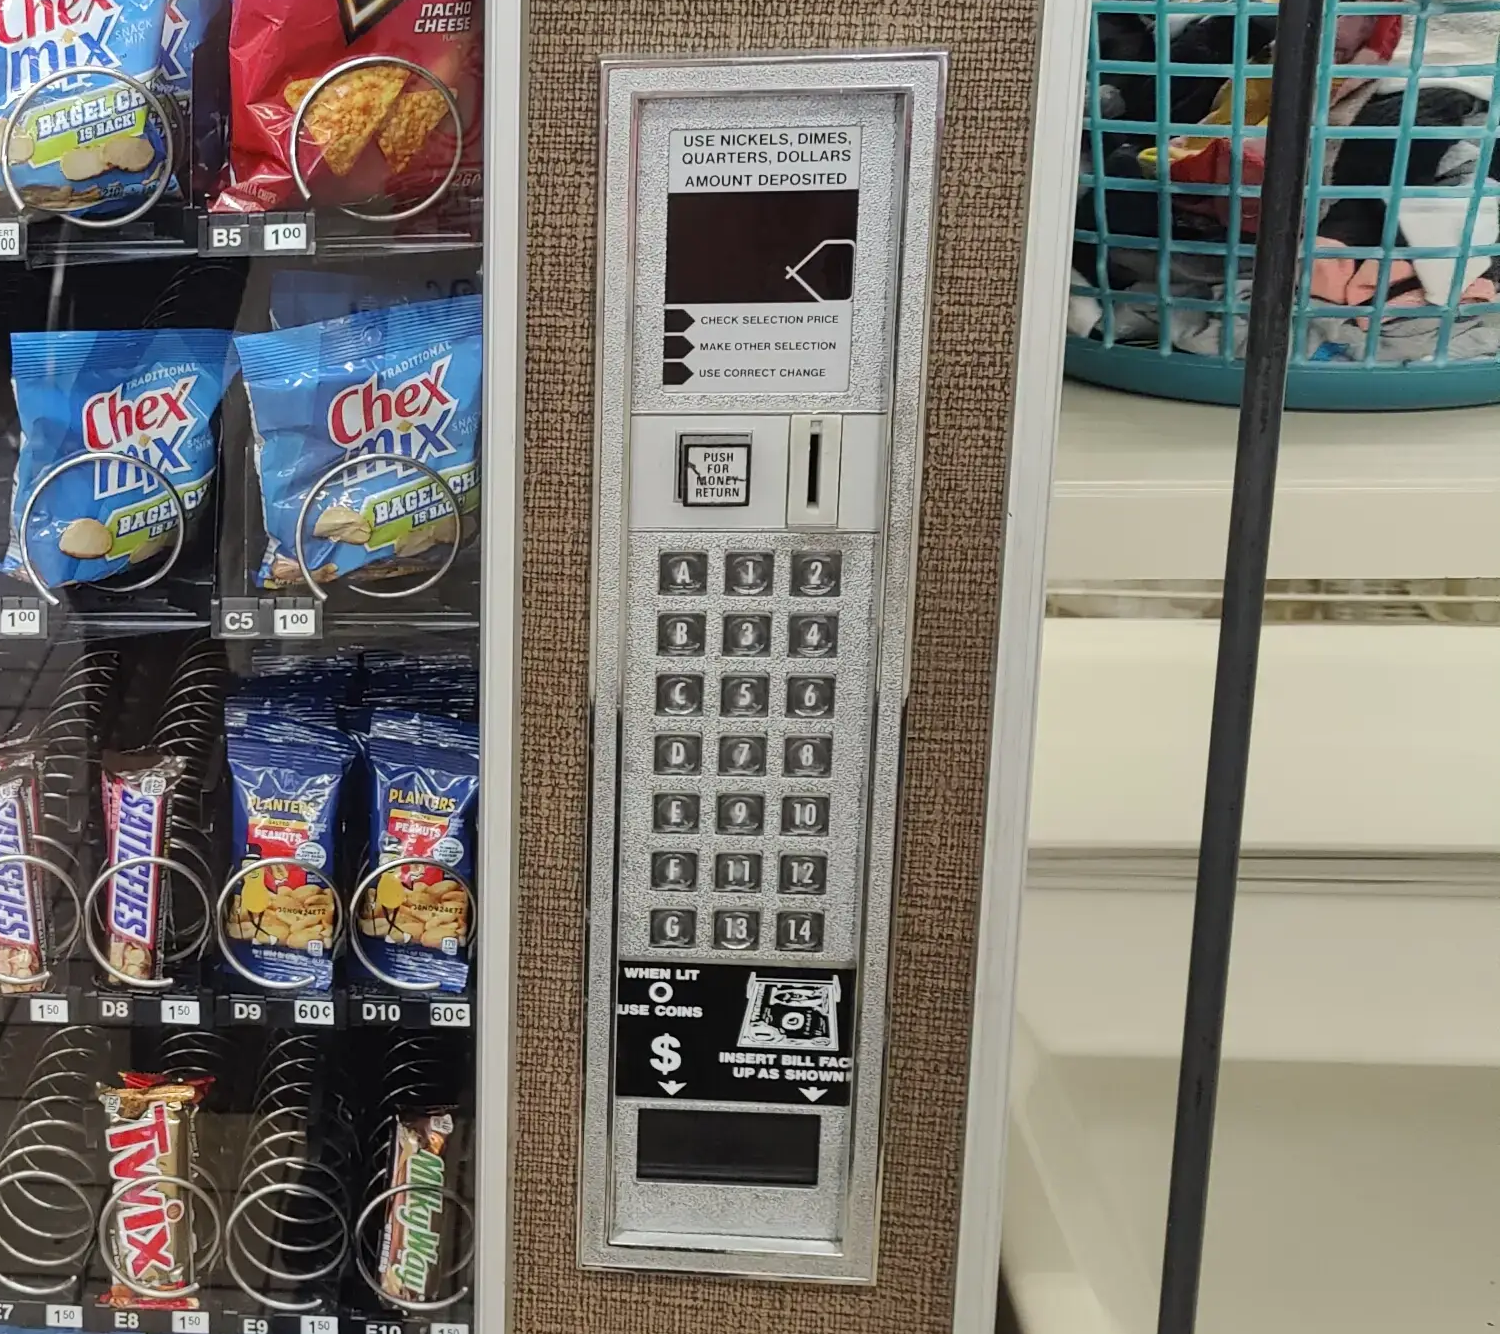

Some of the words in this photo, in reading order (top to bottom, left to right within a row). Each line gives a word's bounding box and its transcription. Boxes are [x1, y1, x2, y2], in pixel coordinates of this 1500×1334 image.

[421, 1, 473, 17] NACHO
[414, 17, 472, 33] CHEESE
[38, 96, 112, 141] BAGEL
[683, 134, 714, 147] USE
[720, 133, 794, 147] NICKELS,
[797, 131, 852, 146] DIMES,
[682, 151, 772, 165] QUARTERS,
[777, 149, 851, 163] DOLLARS
[685, 174, 753, 188] AMOUNT
[758, 172, 847, 186] DEPOSITED
[213, 228, 242, 247] B5
[700, 315, 739, 325] CHECK
[742, 314, 803, 325] SELECTION
[806, 314, 839, 324] PRICE
[700, 341, 731, 351] MAKE
[734, 341, 770, 351] OTHER
[773, 340, 837, 351] SELECTION
[381, 342, 452, 381] TRADITIONAL
[126, 363, 199, 391] TRADITIONAL
[699, 368, 722, 378] USE
[725, 368, 776, 378] CORRECT
[779, 367, 826, 378] CHANGE
[332, 363, 451, 445] Chex
[86, 382, 189, 450] Chex
[346, 408, 452, 479] mix
[703, 452, 733, 463] PUSH
[707, 464, 729, 474] FOR
[696, 476, 739, 486] MONEY
[695, 487, 740, 499] RETURN
[375, 483, 445, 524] BAGEL
[225, 611, 253, 631] C5
[249, 796, 316, 815] PLANTERS
[389, 788, 456, 811] PLANTERS
[793, 803, 817, 826] 10
[254, 829, 303, 845] PEANUTS
[394, 822, 442, 839] PEANUTS
[727, 860, 750, 882] 11
[790, 861, 814, 883] 12
[725, 917, 747, 938] 13
[788, 919, 811, 940] 14
[624, 967, 671, 980] WHEN
[676, 969, 700, 981] LIT
[102, 1002, 127, 1018] D8
[234, 1004, 261, 1020] D9
[362, 1005, 399, 1022] D10
[618, 1004, 649, 1016] USE
[655, 1005, 703, 1018] COINS
[650, 1033, 681, 1075] $
[719, 1052, 777, 1065] INSERT
[781, 1054, 815, 1067] BILL
[733, 1067, 755, 1079] UP
[757, 1068, 780, 1080] AS
[114, 1311, 140, 1328] E8
